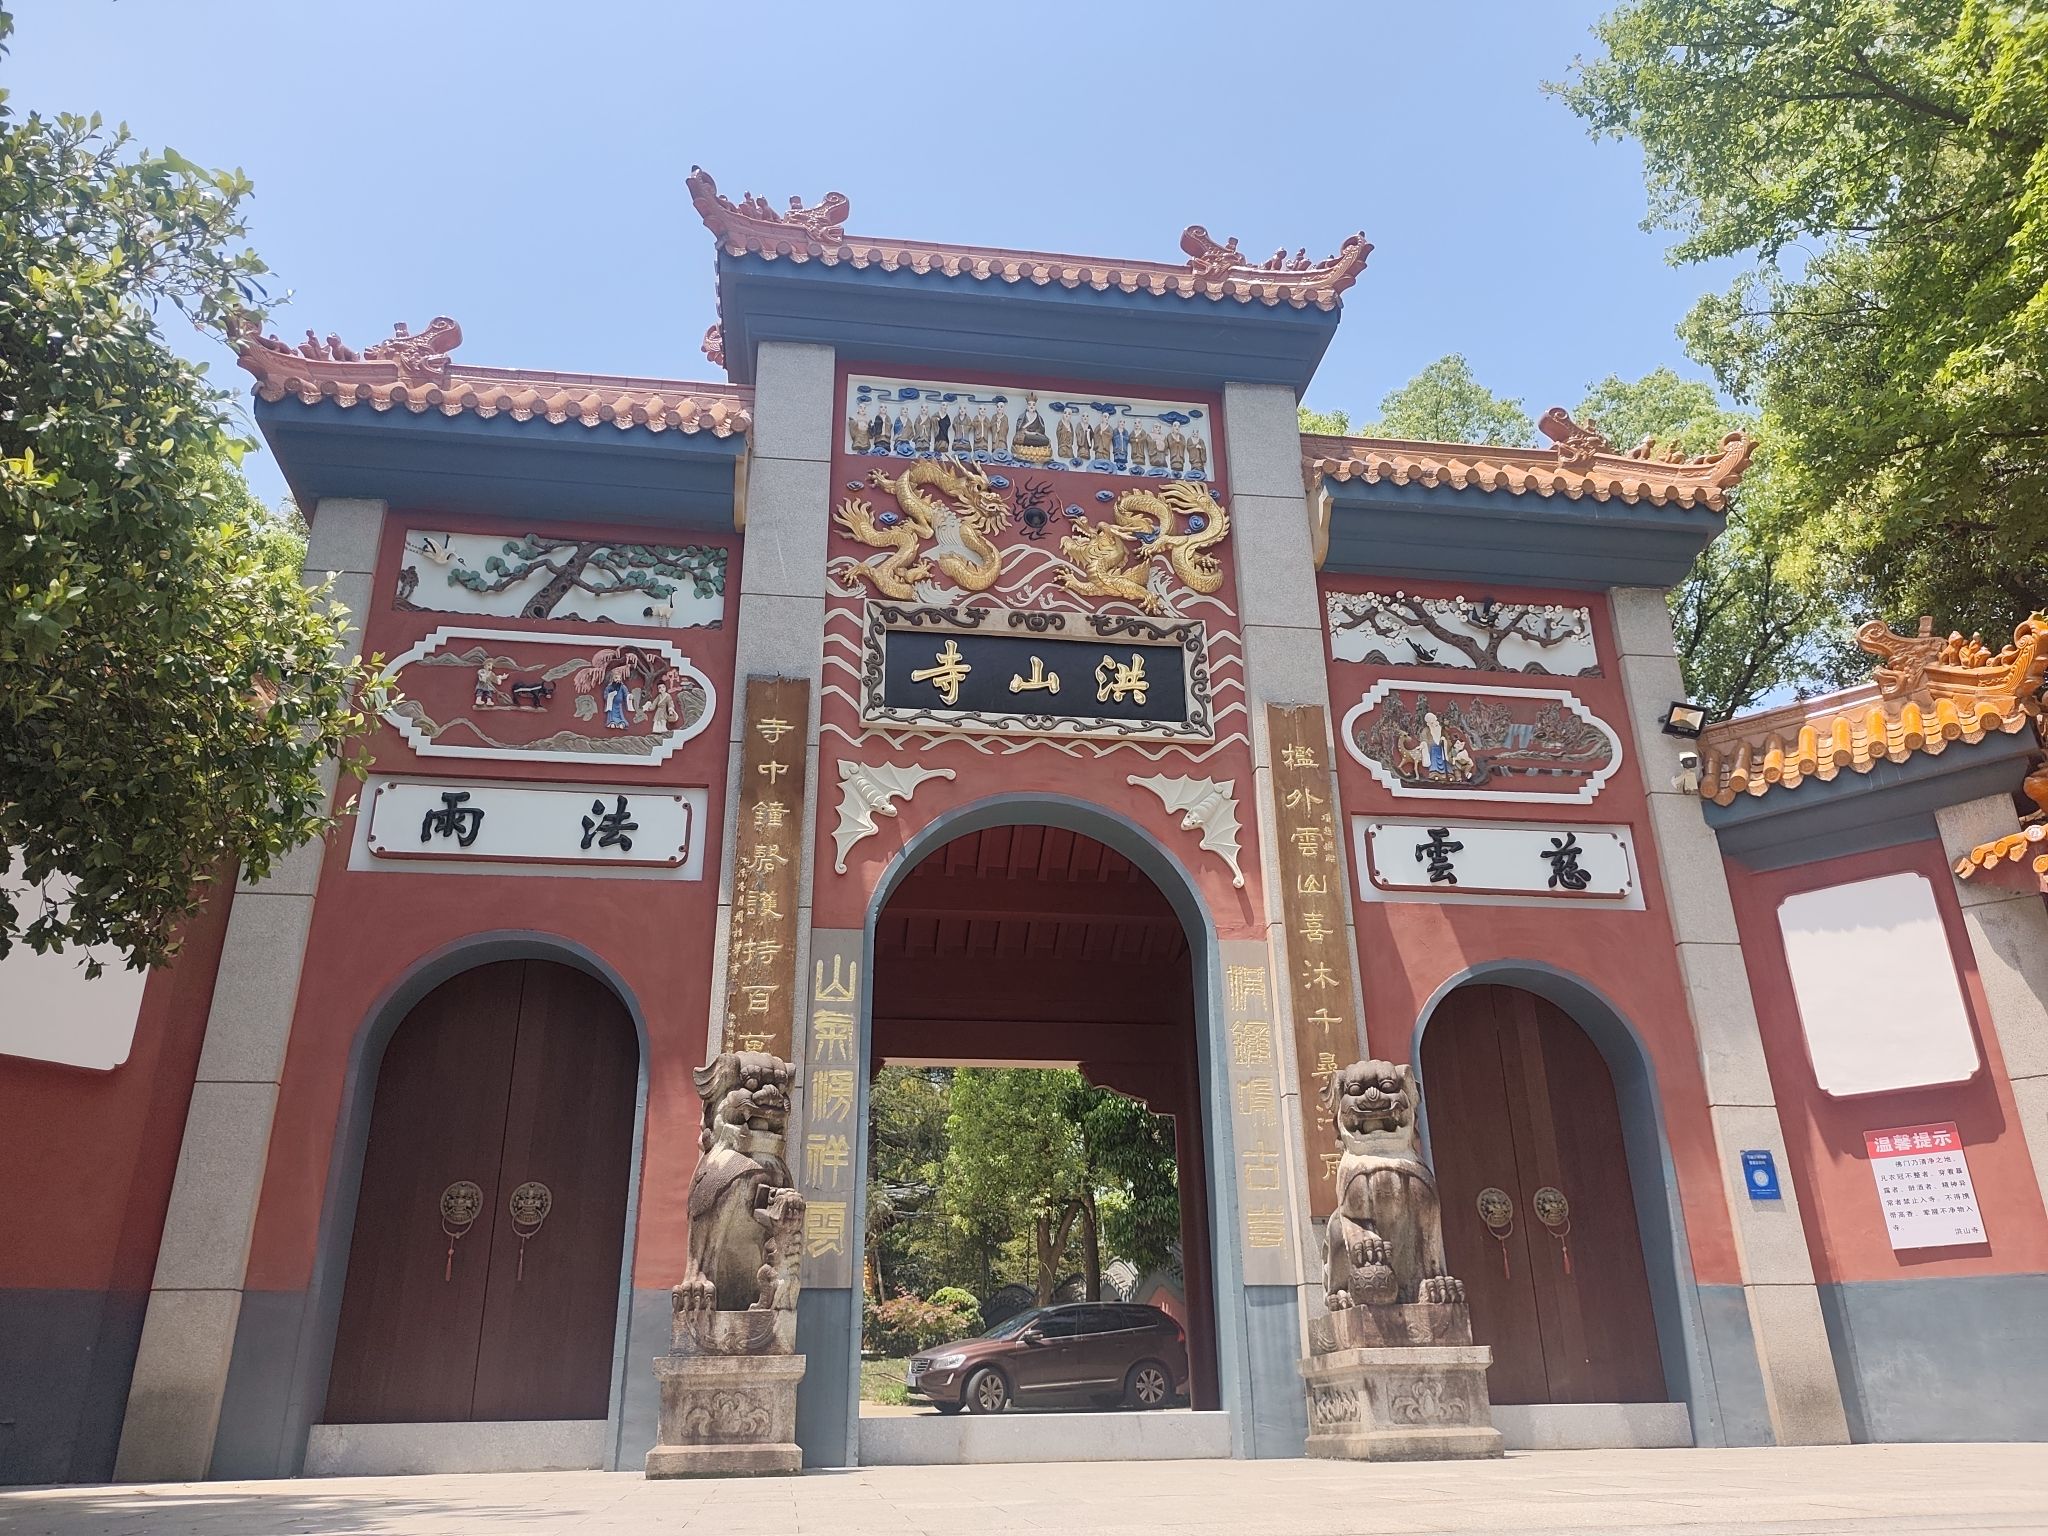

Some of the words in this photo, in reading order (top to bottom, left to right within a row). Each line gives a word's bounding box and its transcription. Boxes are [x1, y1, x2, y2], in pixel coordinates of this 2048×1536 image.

[1874, 1130, 1952, 1153] 温馨提示
[1954, 1226, 1979, 1235] 洪山寺
